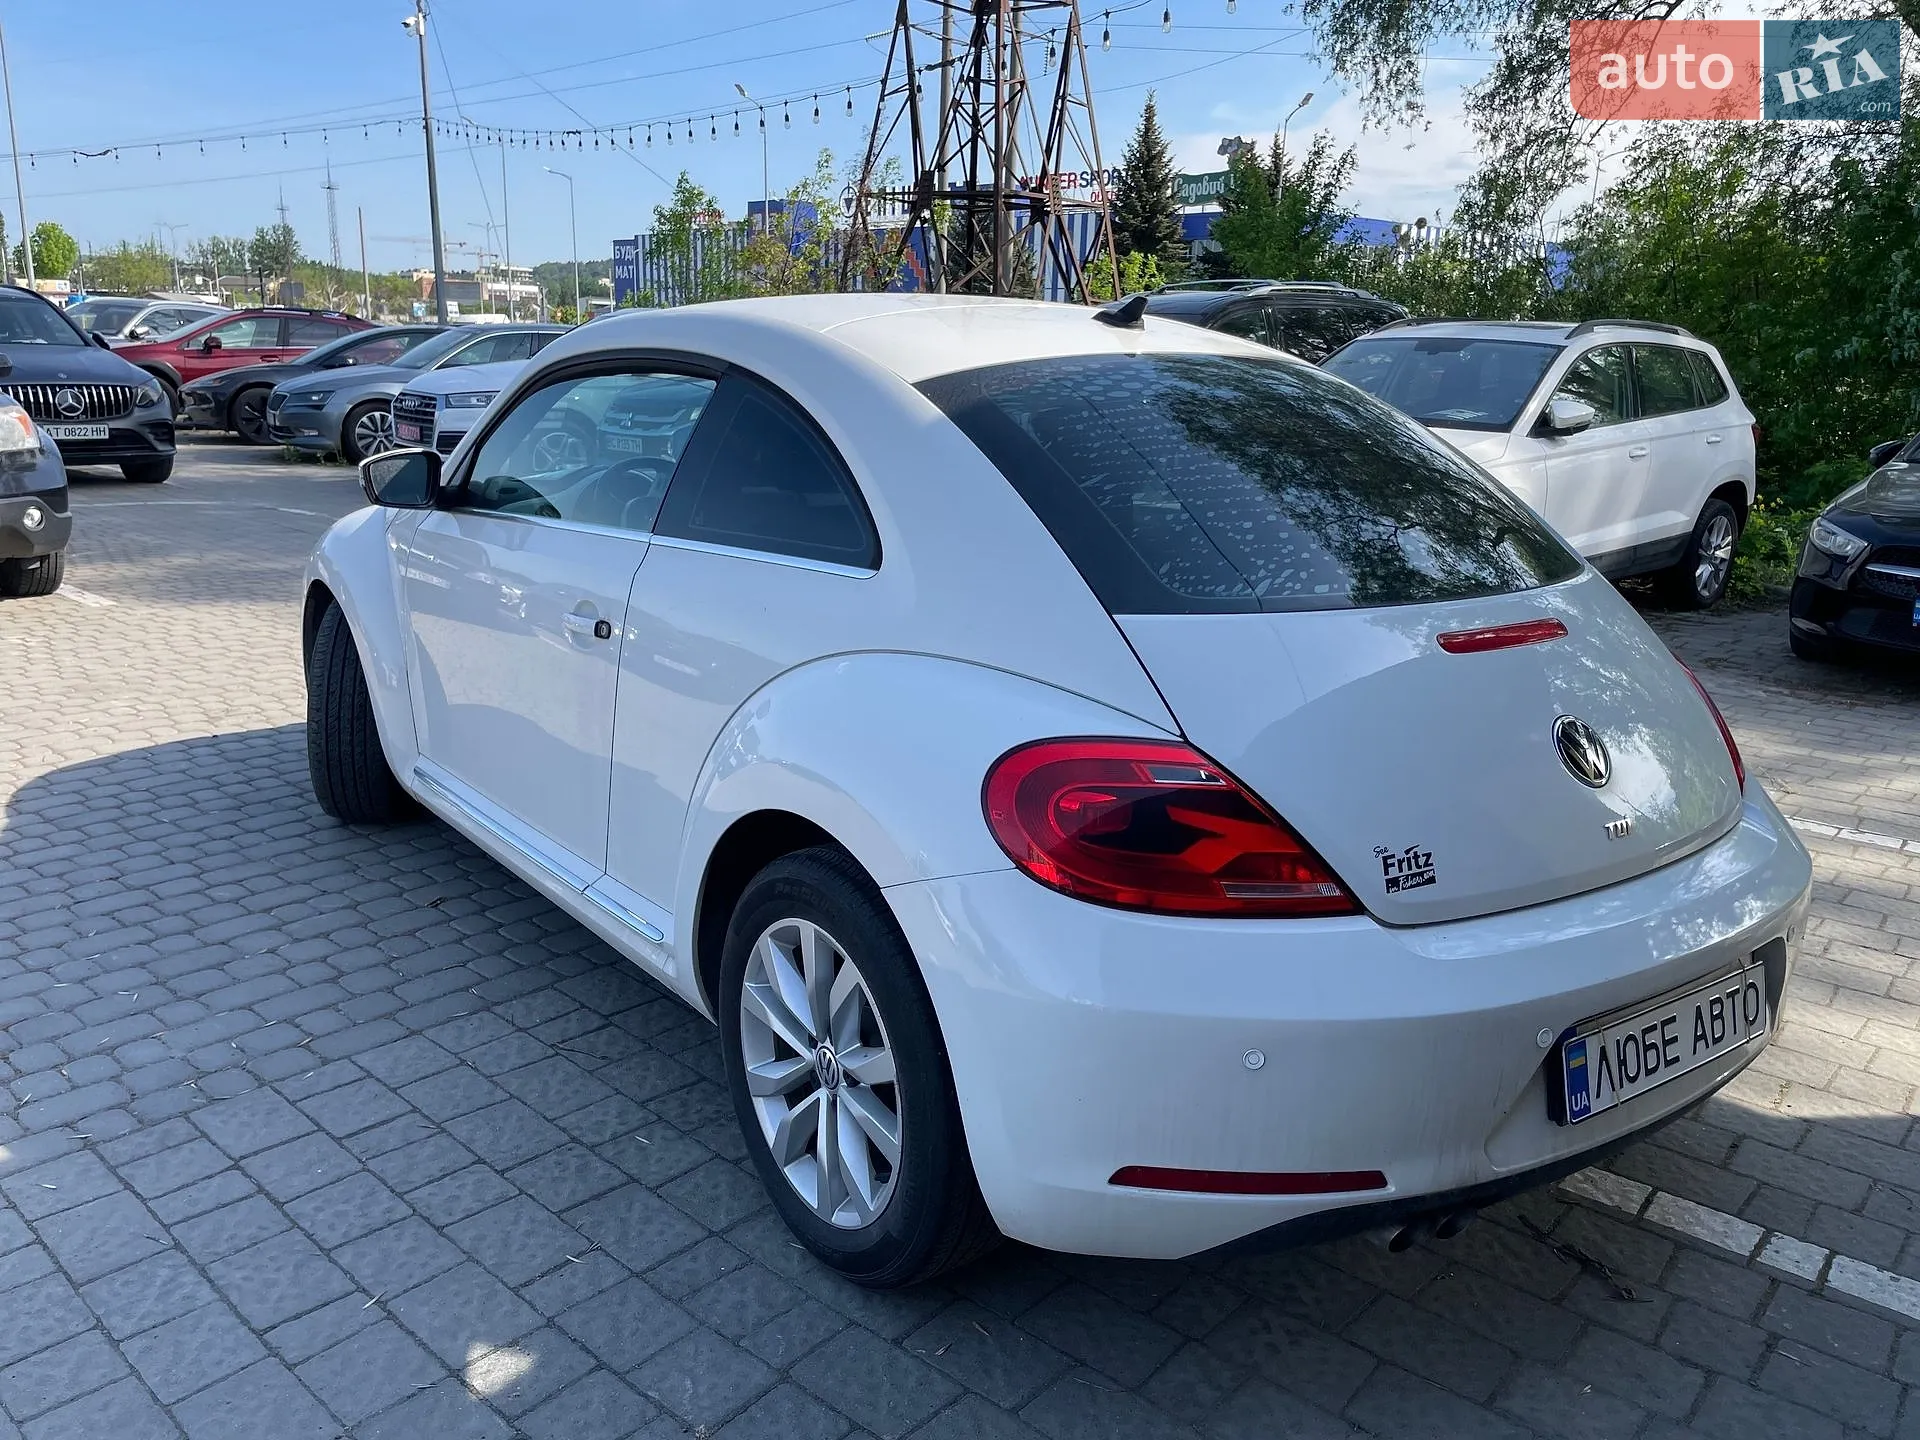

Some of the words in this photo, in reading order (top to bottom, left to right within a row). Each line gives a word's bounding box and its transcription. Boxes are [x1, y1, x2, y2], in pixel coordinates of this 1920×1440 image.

[64, 427, 89, 437] 0822
[1604, 818, 1633, 841] TDI
[1373, 845, 1390, 858] See
[1381, 845, 1434, 876] Fritz
[1595, 1012, 1681, 1100] ЛЮБЕ
[1692, 979, 1760, 1056] АВТО
[1571, 1090, 1590, 1112] UA
